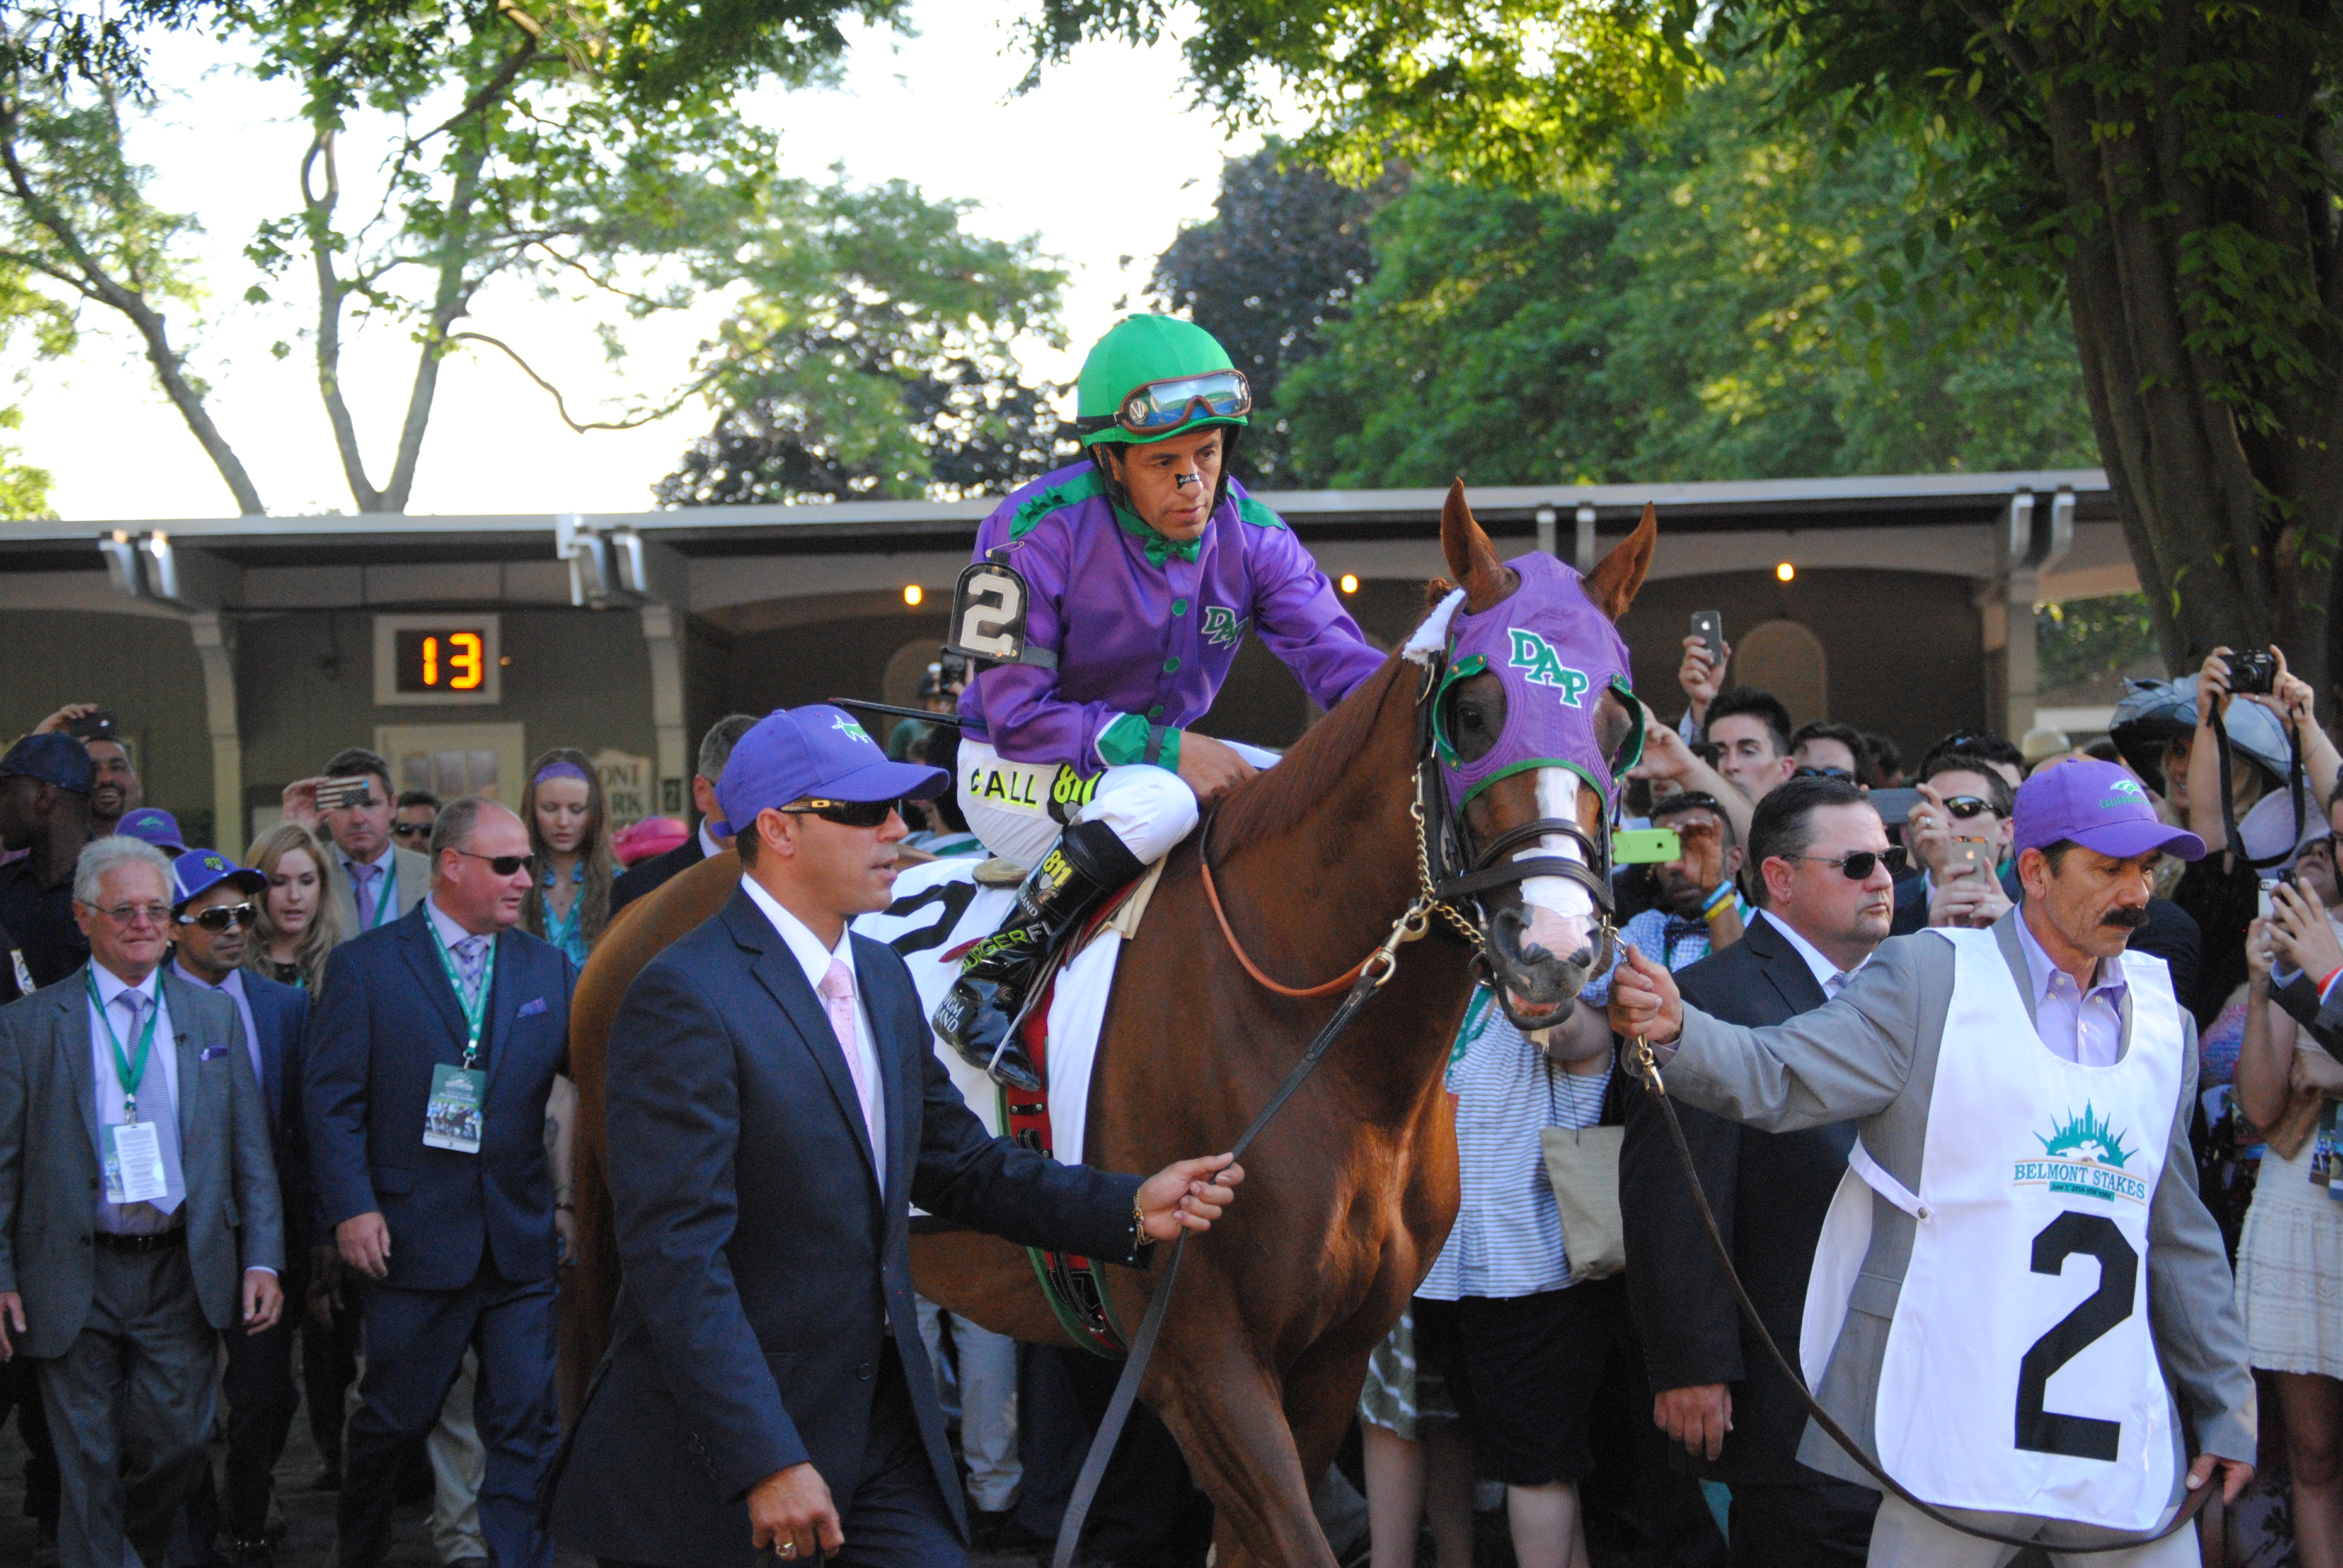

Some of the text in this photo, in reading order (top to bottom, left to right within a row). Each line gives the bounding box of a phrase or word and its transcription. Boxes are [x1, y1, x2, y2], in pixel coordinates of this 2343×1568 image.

[960, 573, 1020, 655] 2
[423, 633, 482, 689] 13
[1508, 627, 1589, 708] DAP
[971, 768, 1038, 809] CALL
[1043, 849, 1073, 887] 811
[2013, 1163, 2145, 1200] BELMONT STAKES
[2099, 1190, 2111, 1199] YORK
[2014, 1210, 2138, 1462] 2
